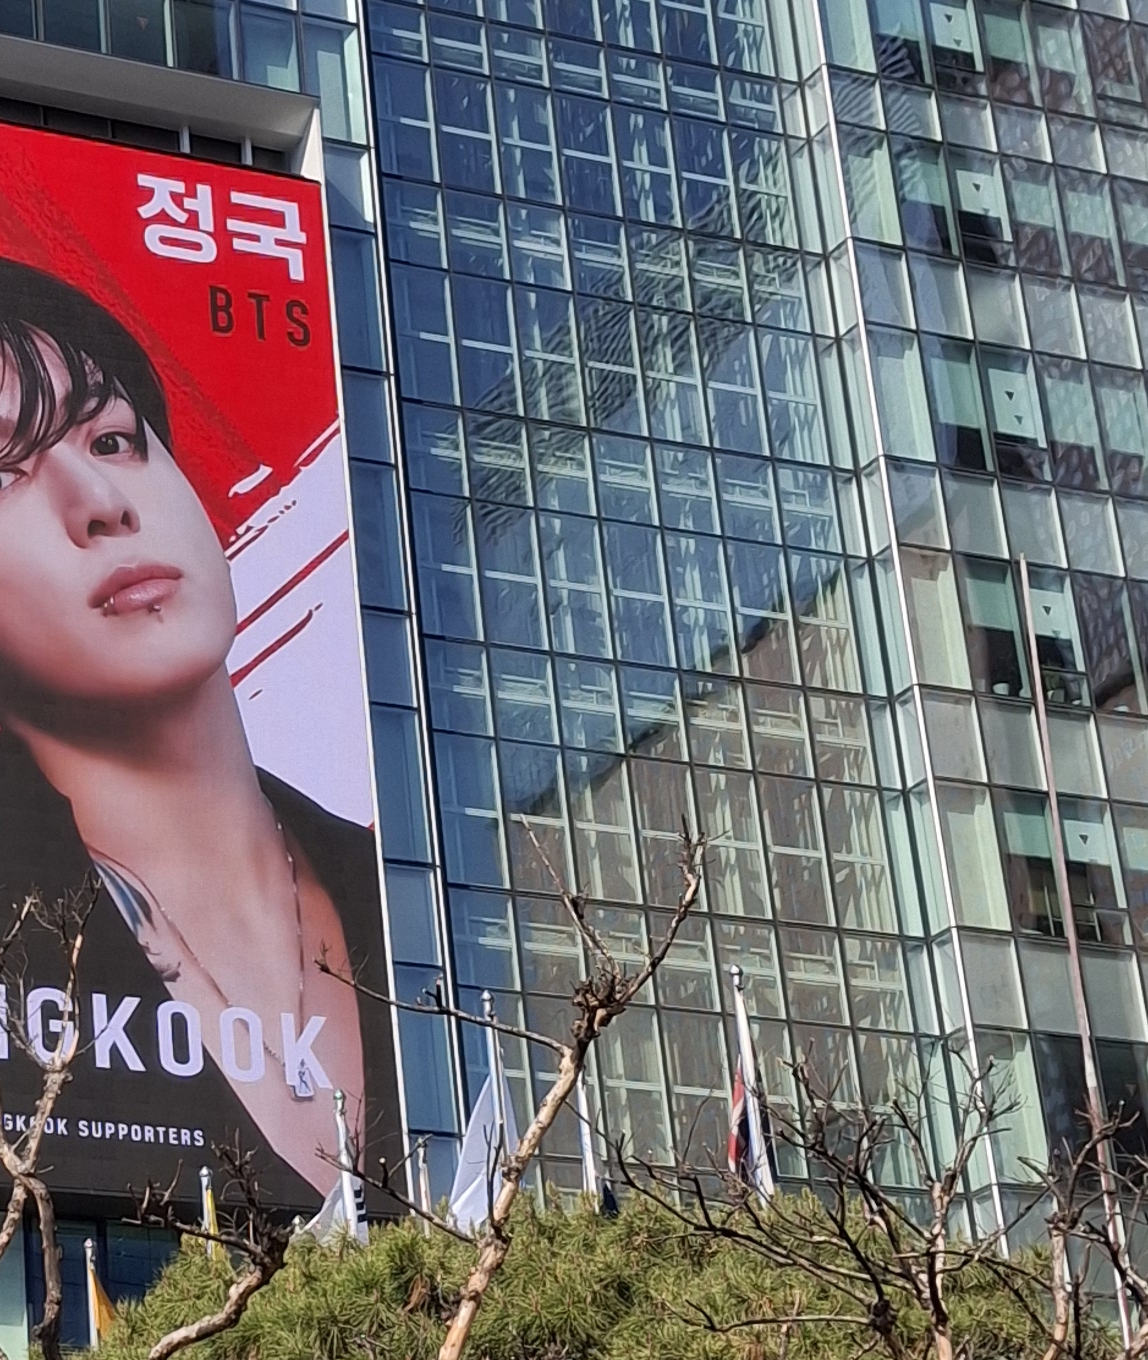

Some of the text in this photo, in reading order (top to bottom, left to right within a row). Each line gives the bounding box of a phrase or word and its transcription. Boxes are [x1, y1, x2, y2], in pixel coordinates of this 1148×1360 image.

[137, 173, 307, 282] 정국
[209, 285, 311, 347] BTS
[78, 1120, 204, 1147] SUPPORTERS
